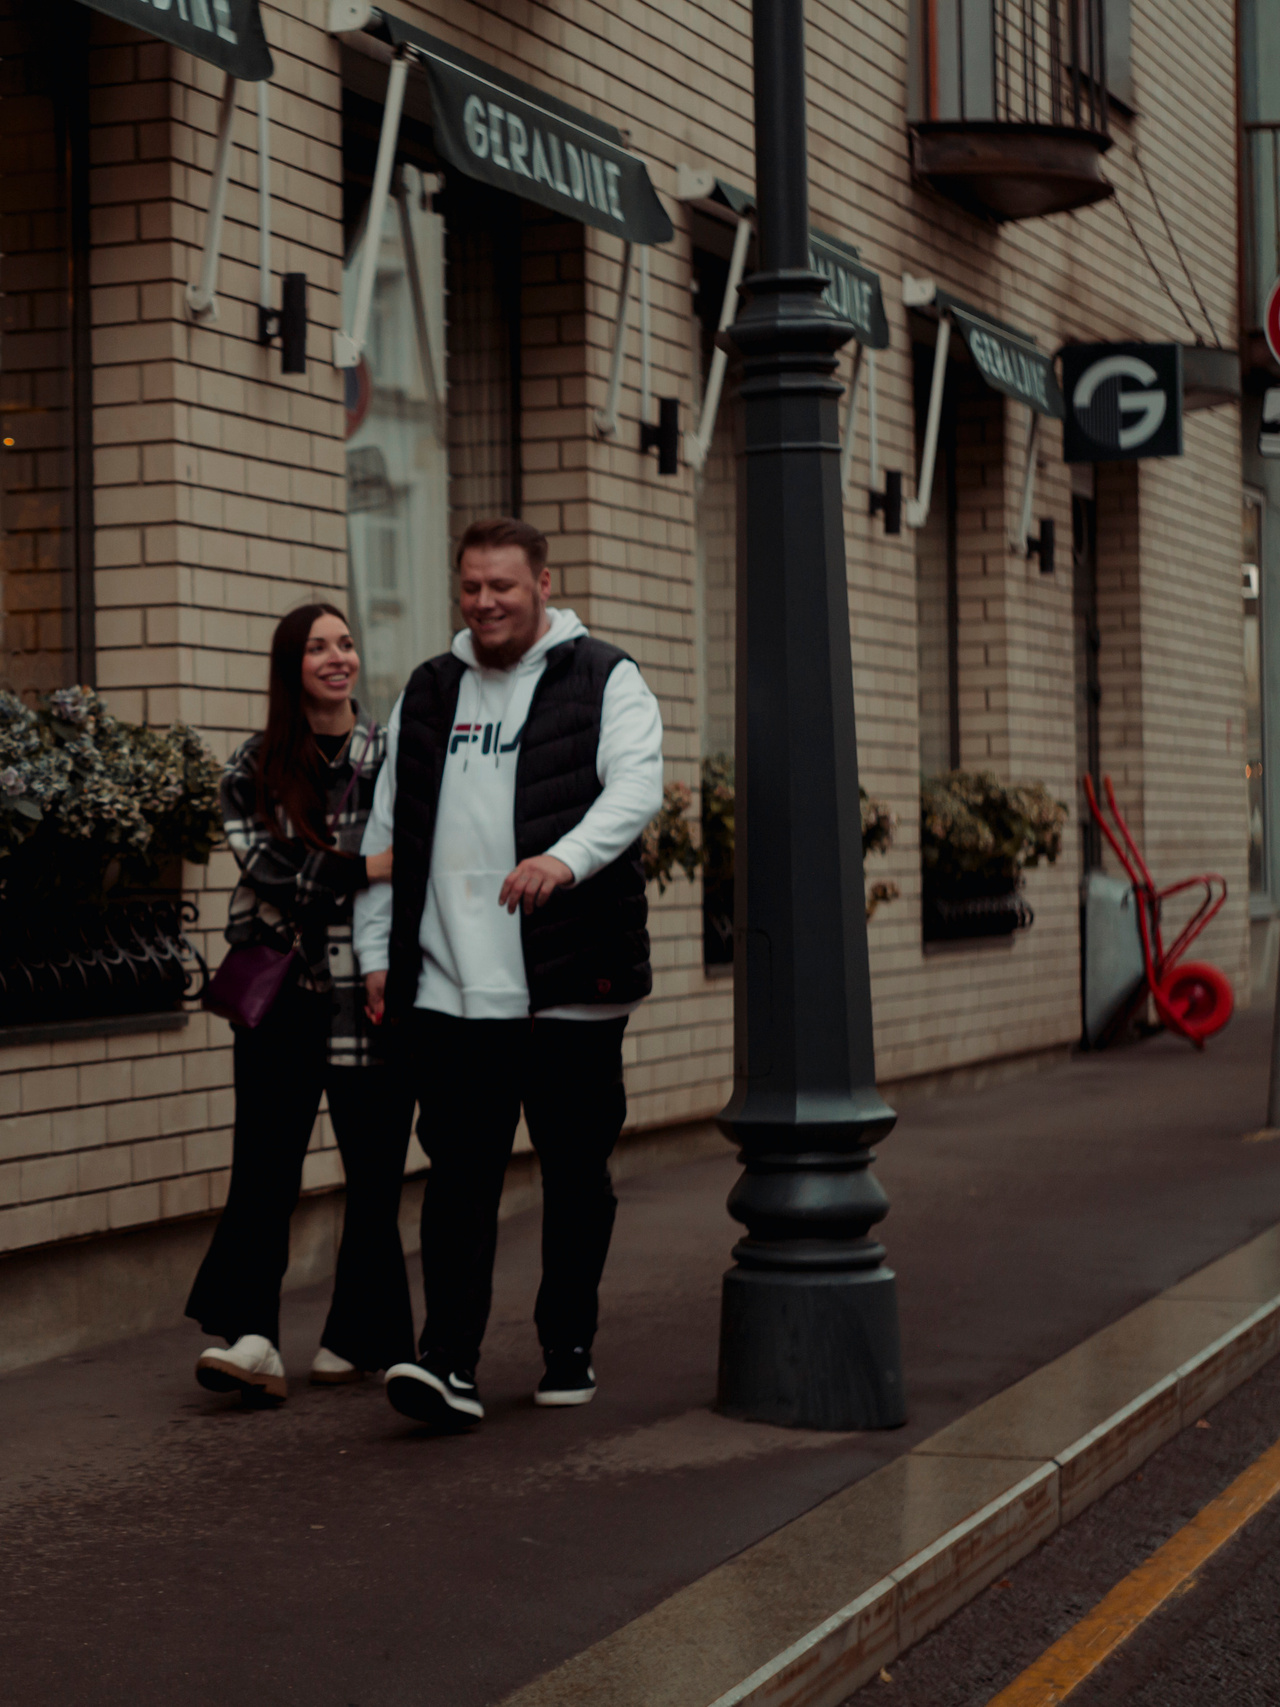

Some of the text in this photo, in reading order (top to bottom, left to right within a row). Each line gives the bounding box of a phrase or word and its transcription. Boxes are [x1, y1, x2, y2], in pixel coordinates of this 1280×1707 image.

[463, 94, 625, 223] GERALDINE
[1073, 355, 1167, 450] G
[450, 722, 521, 755] FIL
